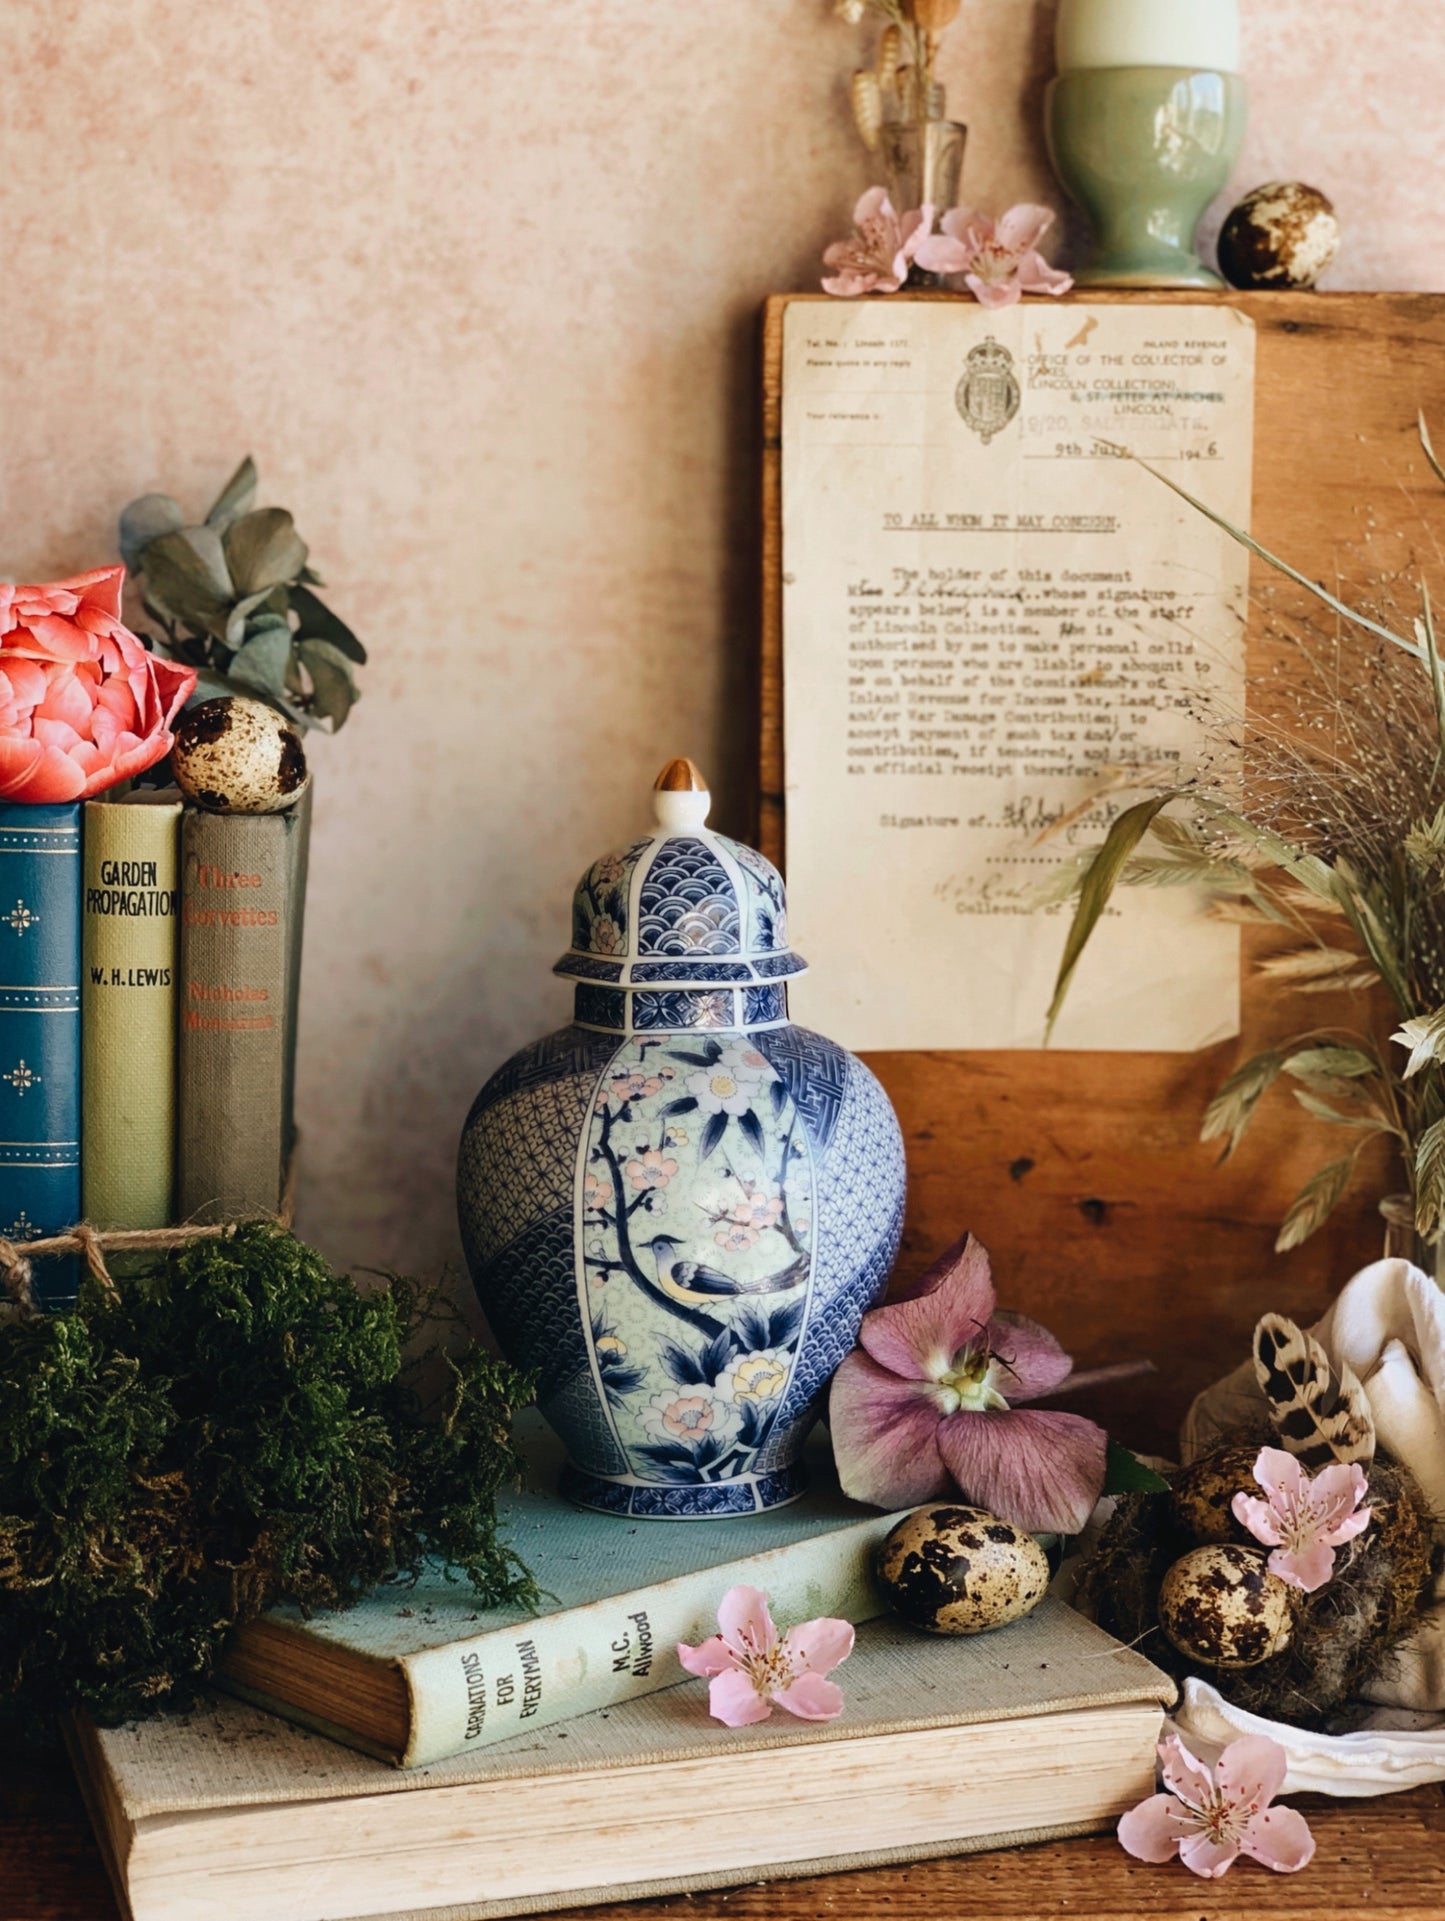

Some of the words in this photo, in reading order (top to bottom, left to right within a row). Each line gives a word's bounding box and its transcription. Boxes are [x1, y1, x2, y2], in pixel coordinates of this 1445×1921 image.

[1143, 340, 1179, 349] INLAND
[1185, 340, 1227, 349] REVENUE
[1076, 354, 1091, 366] OF
[1100, 354, 1124, 366] THE
[1131, 354, 1204, 366] COLLECTOR
[1211, 354, 1227, 366] OF
[1055, 442, 1082, 458] 9th
[882, 512, 903, 526] TO
[910, 512, 939, 527] ALL
[945, 513, 982, 527] WHOM
[992, 513, 1009, 527] IT
[1016, 514, 1044, 528] MAY
[892, 567, 918, 581] The
[929, 567, 982, 581] holder
[990, 567, 1008, 581] of
[1018, 568, 1052, 582] this
[1061, 569, 1132, 583] document
[1097, 588, 1176, 603] signature
[849, 605, 910, 618] appears
[981, 604, 998, 617] is
[1023, 605, 1078, 618] member
[1114, 606, 1140, 619] the
[1149, 605, 1194, 619] staff
[848, 621, 866, 634] of
[873, 620, 938, 635] Lincoln
[1095, 623, 1113, 636] is
[945, 638, 964, 655] by
[970, 642, 989, 652] me
[998, 640, 1016, 652] to
[1023, 641, 1060, 655] make
[1069, 641, 1140, 657] personal
[848, 658, 884, 672] upon
[892, 658, 955, 672] persons
[962, 657, 989, 670] who
[998, 660, 1024, 670] are
[1033, 657, 1087, 672] liable
[848, 676, 866, 687] me
[873, 676, 893, 687] on
[900, 674, 955, 687] behalf
[962, 674, 981, 687] of
[989, 675, 1016, 687] the
[848, 691, 901, 704] Inland
[907, 691, 971, 704] Revenue
[979, 692, 1007, 706] for
[1015, 691, 1067, 706] Income
[906, 709, 936, 722] War
[943, 709, 997, 725] Damage
[1130, 713, 1147, 725] to
[848, 728, 900, 742] accept
[909, 728, 970, 742] payment
[977, 728, 996, 740] of
[969, 744, 987, 758] if
[847, 765, 865, 775] an
[873, 762, 943, 776] official
[952, 763, 1013, 779] receipt
[880, 814, 959, 829] Signature
[101, 860, 157, 887] GARDEN
[195, 863, 262, 889] Three
[87, 888, 177, 917] PROPAGATION
[181, 900, 278, 926] Corvettes
[188, 982, 269, 1002] Nicholas
[184, 1011, 274, 1031] Monsarrat
[611, 1631, 631, 1673] M.C.
[627, 1611, 654, 1678] Allwood
[515, 1639, 542, 1720] EVERYMAN
[461, 1652, 486, 1741] CARNATIONS
[497, 1673, 514, 1707] FOR
